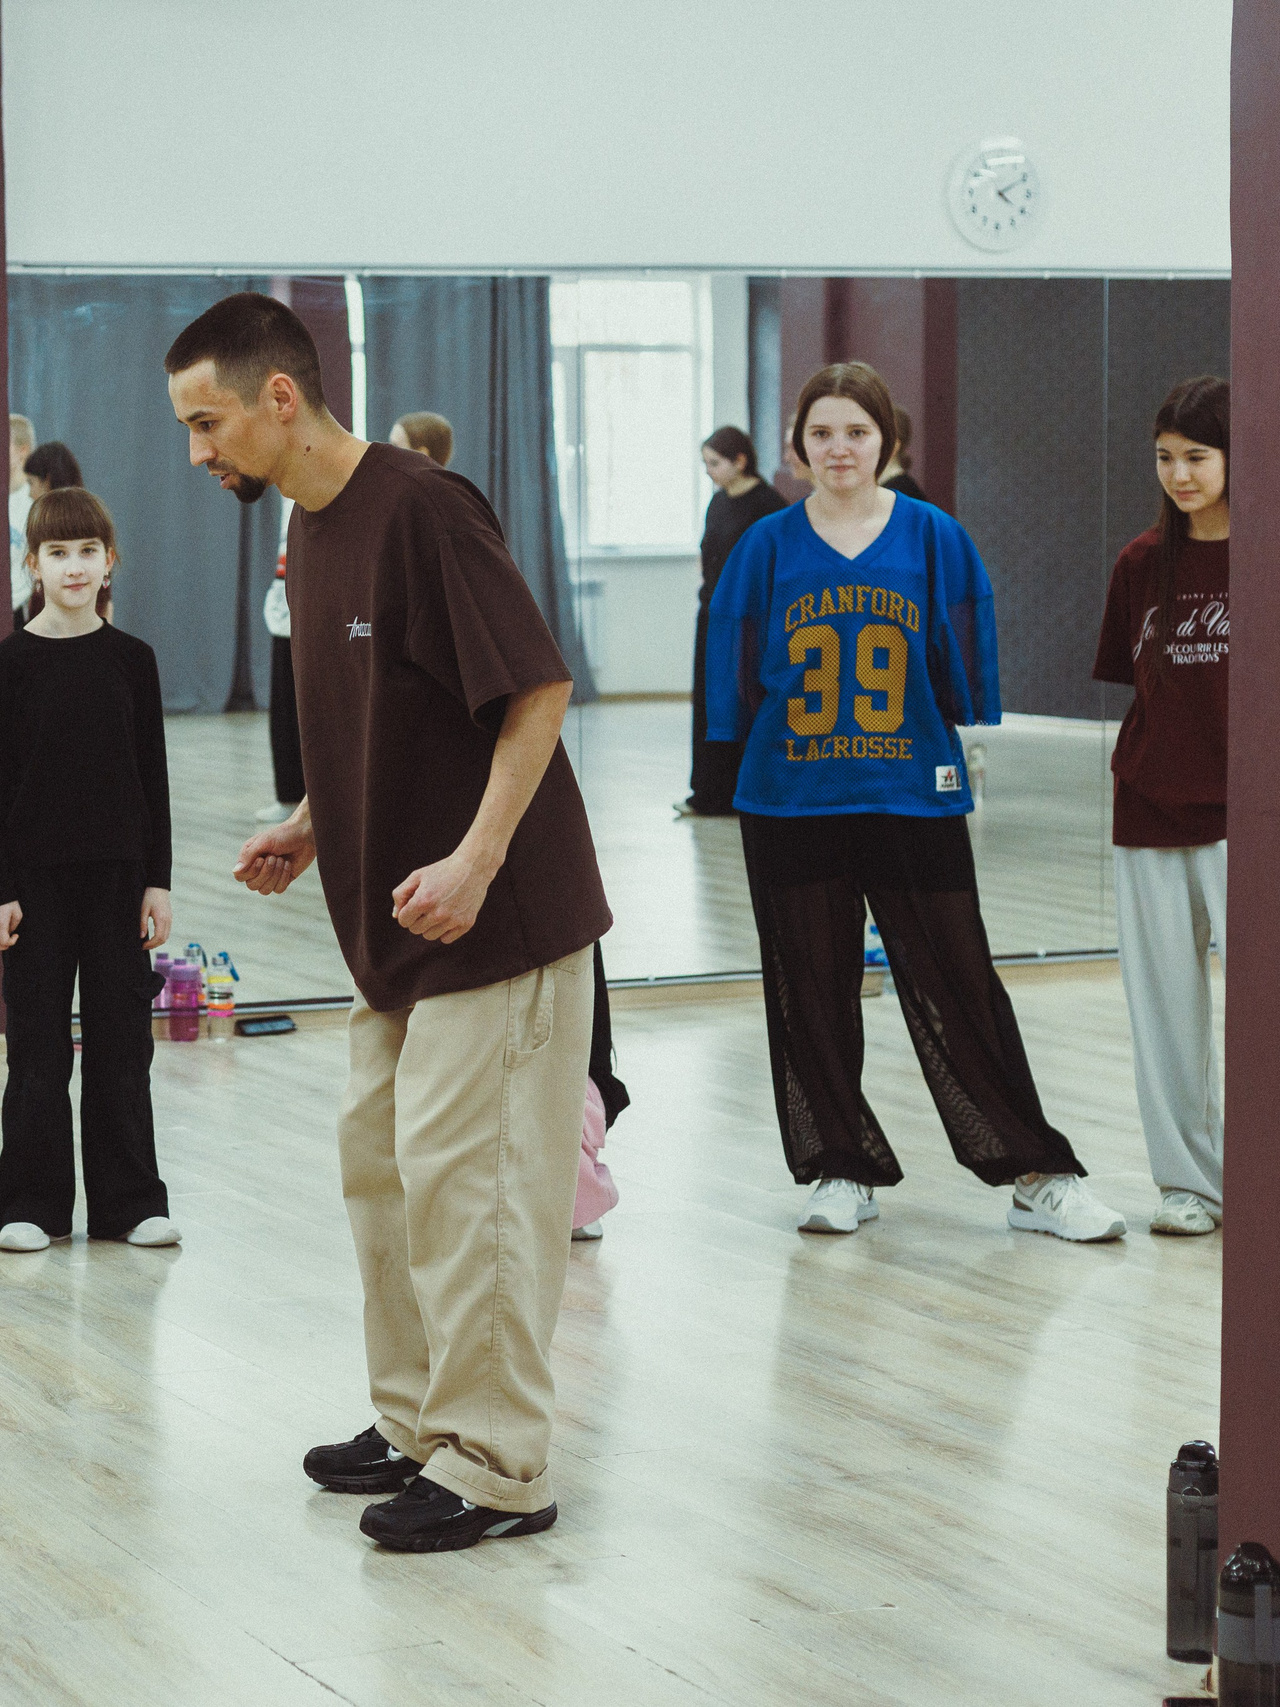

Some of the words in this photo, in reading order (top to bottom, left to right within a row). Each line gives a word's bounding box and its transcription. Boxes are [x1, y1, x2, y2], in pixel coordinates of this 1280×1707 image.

[785, 585, 919, 632] CRANFORD
[1176, 608, 1198, 637] de
[1201, 601, 1230, 637] Va
[1213, 642, 1229, 654] LES
[787, 624, 908, 736] 39
[785, 735, 913, 761] LACROSSE
